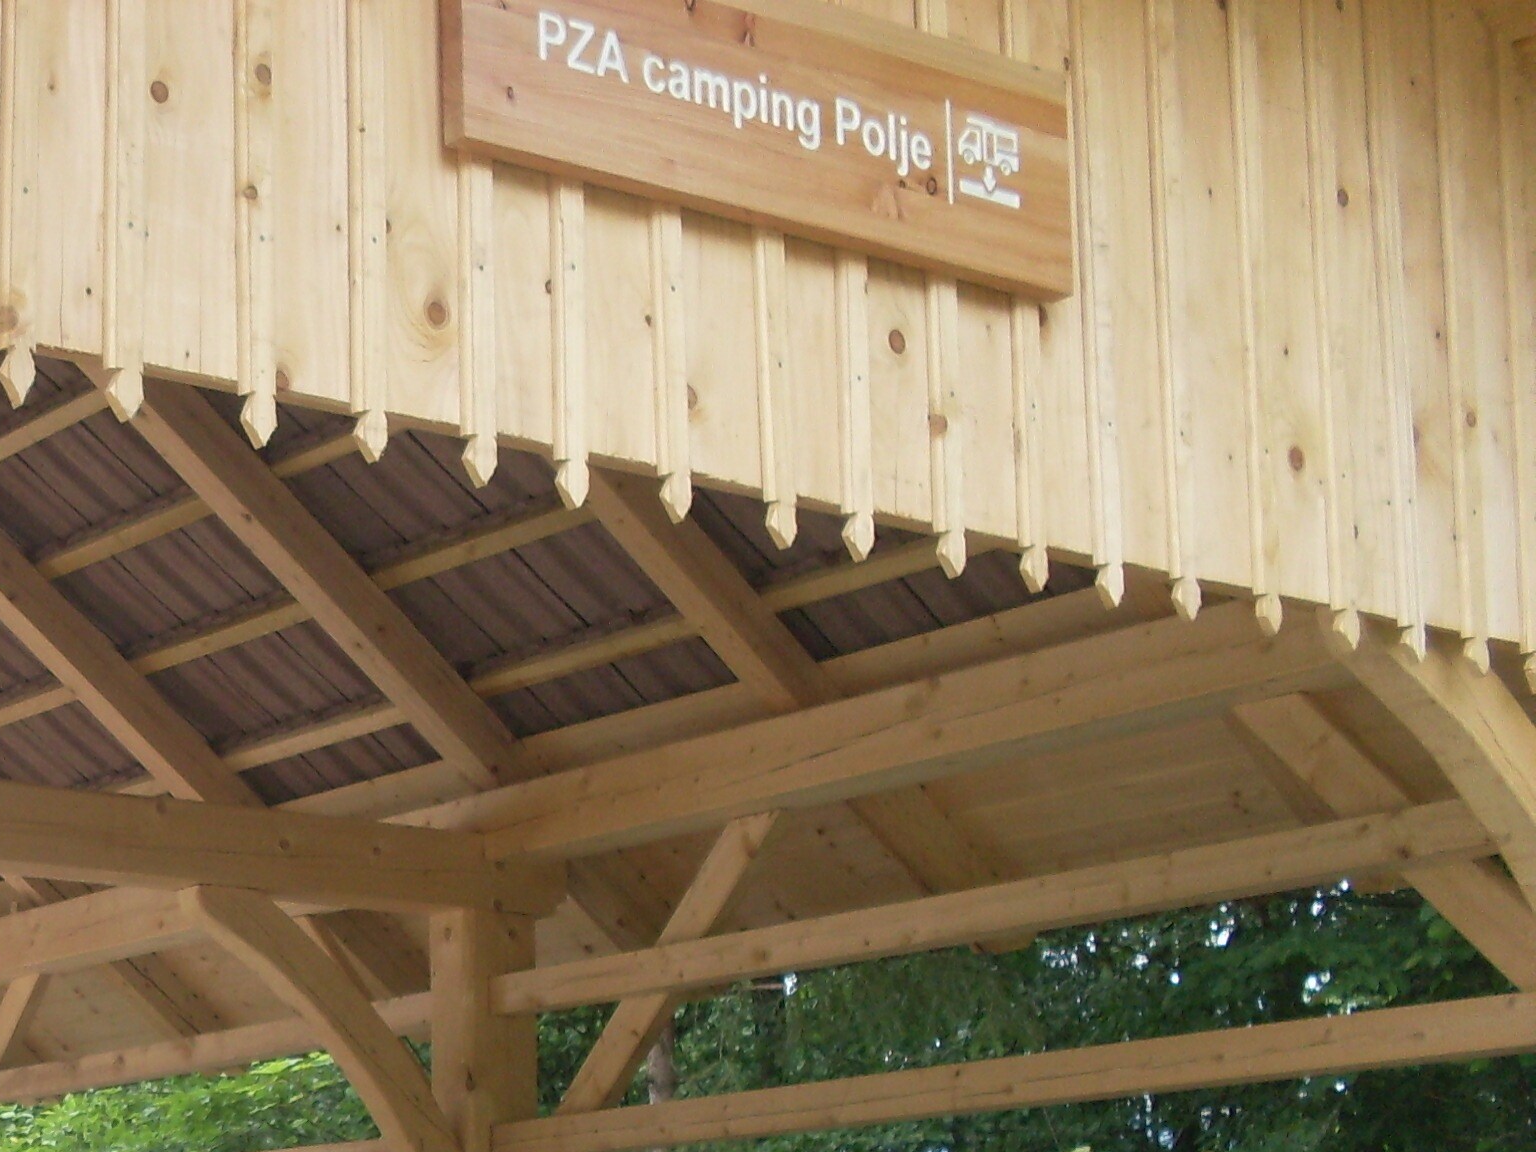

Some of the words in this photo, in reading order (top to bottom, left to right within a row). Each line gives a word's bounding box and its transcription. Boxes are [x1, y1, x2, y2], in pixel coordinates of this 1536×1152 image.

[538, 11, 630, 84] PZA
[643, 54, 821, 150] camping
[835, 97, 933, 177] Polje
